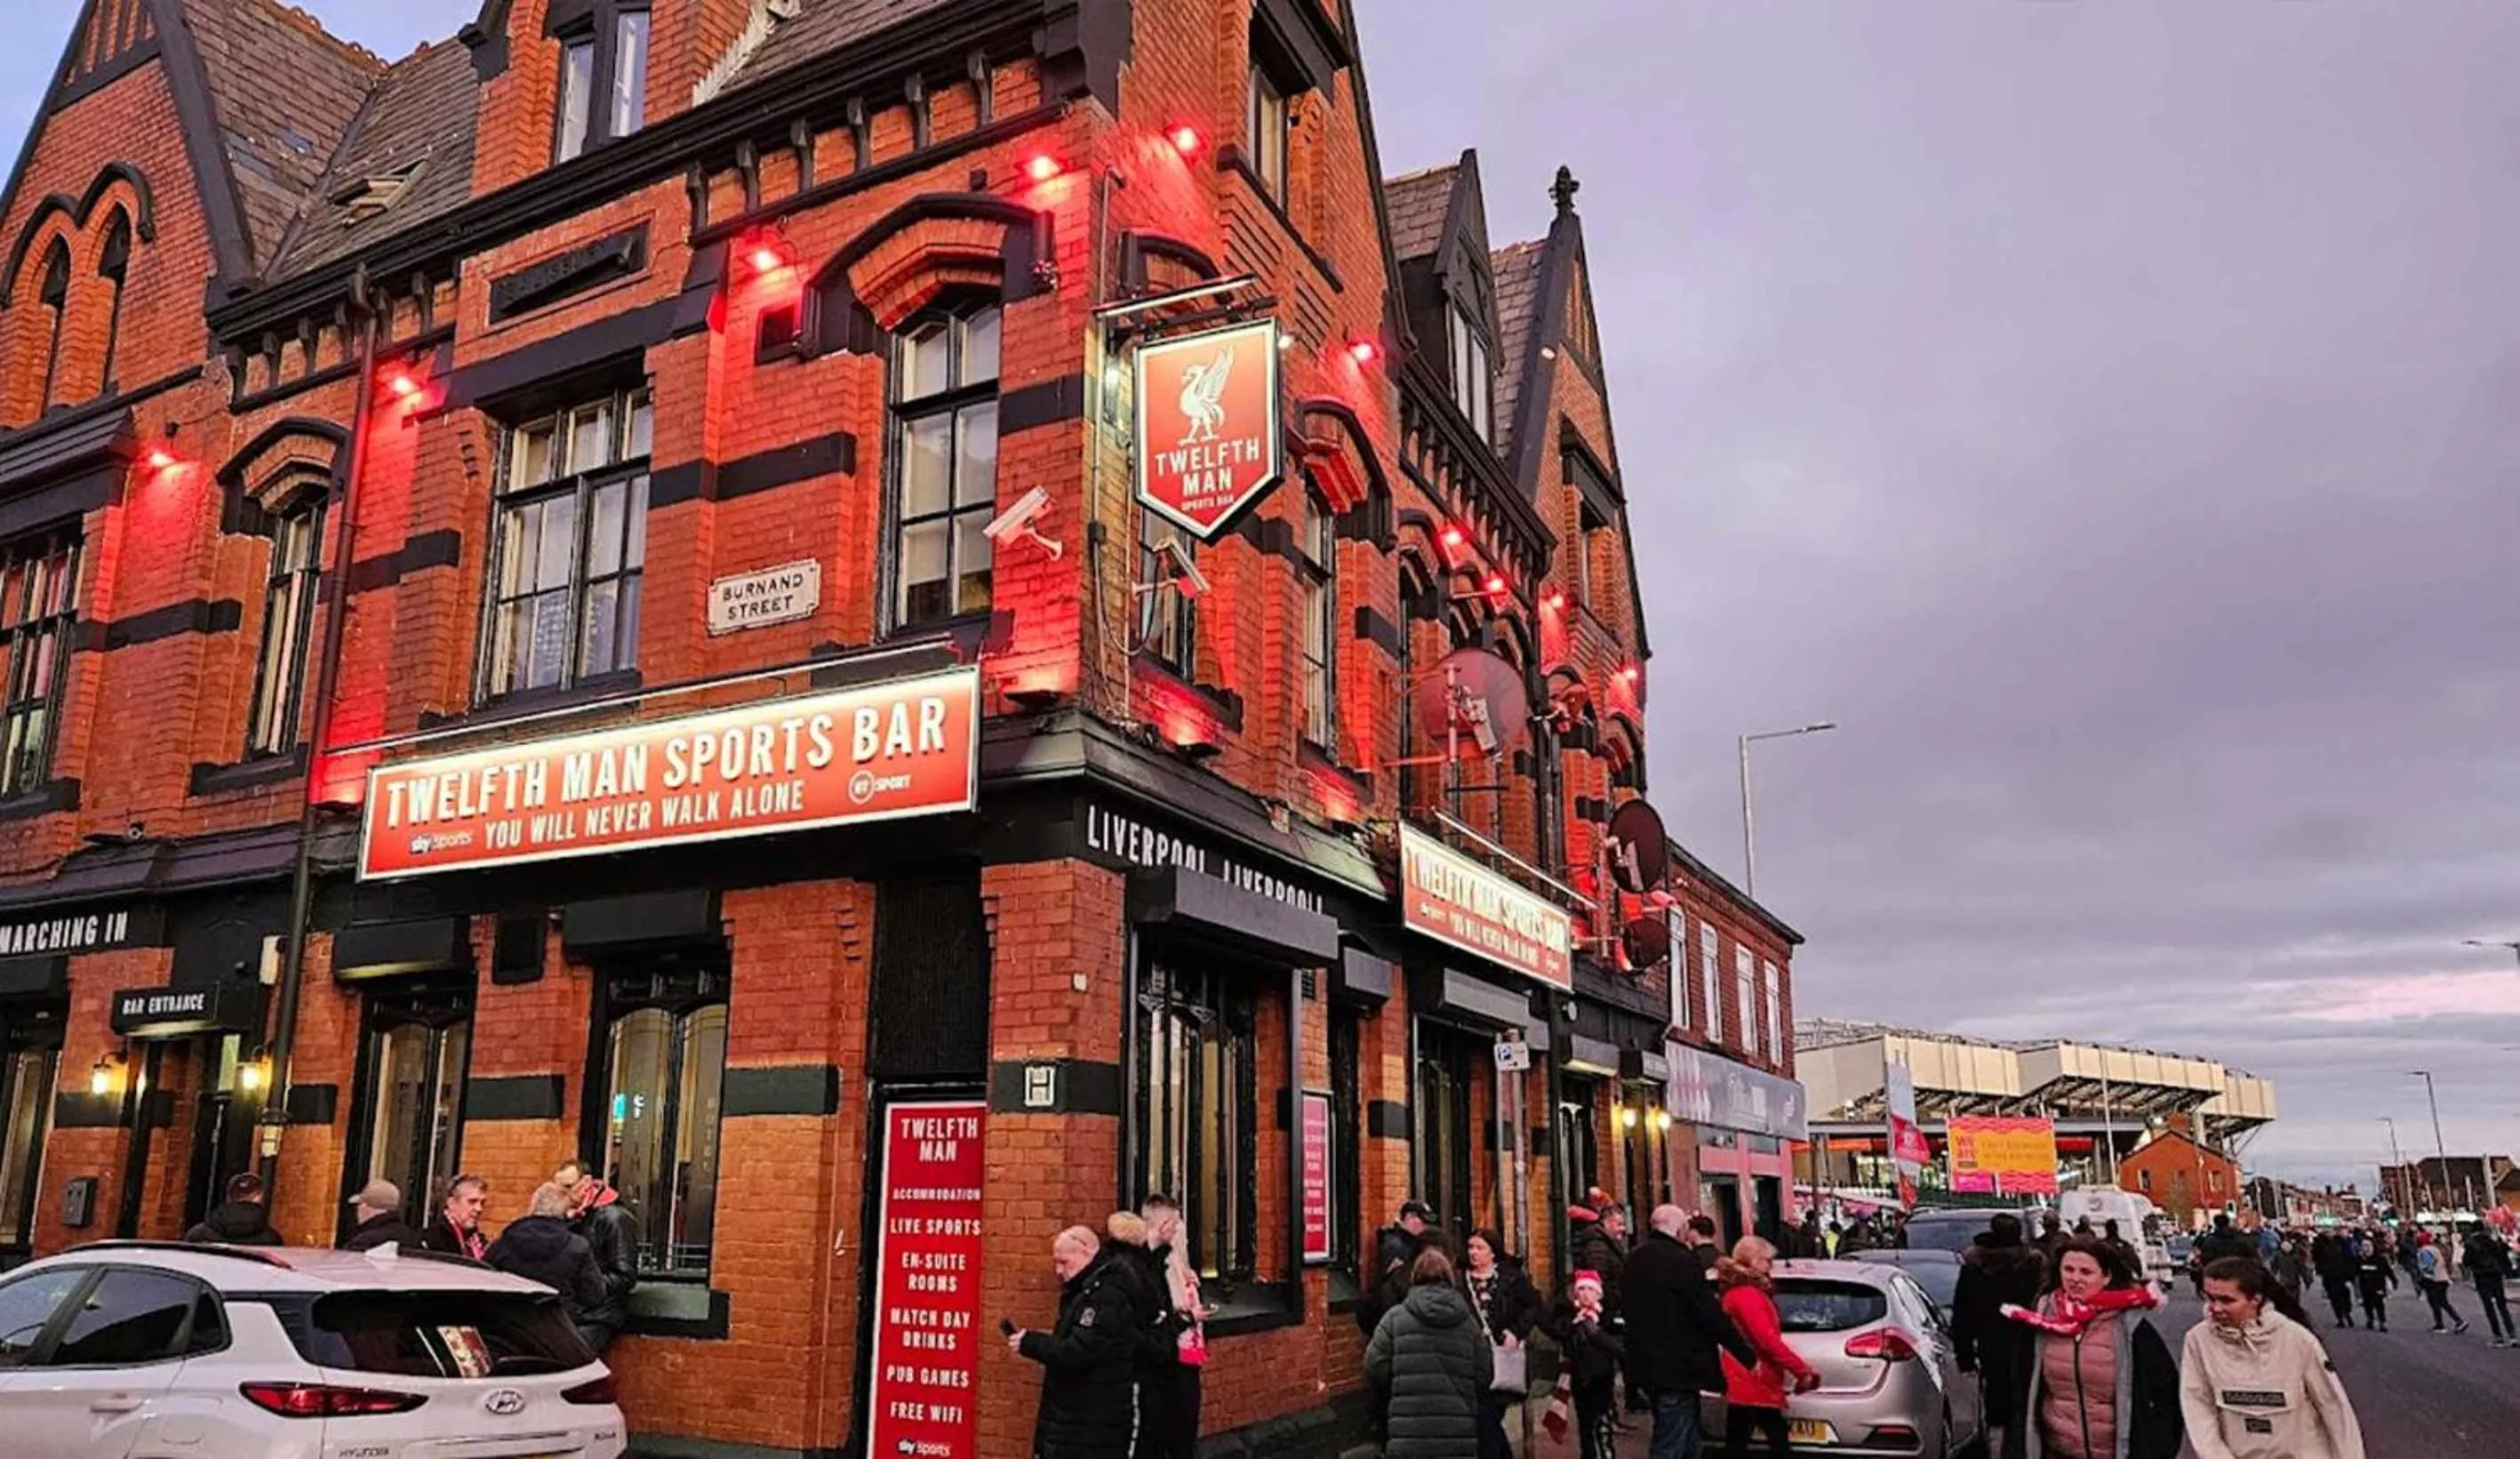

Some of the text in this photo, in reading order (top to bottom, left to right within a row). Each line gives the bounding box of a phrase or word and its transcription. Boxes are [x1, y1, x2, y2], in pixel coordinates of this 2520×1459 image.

[1155, 437, 1260, 476] TWELFTH
[1181, 468, 1233, 496] MAN
[723, 573, 804, 601] BURNAND
[728, 595, 793, 620] STREET
[387, 698, 946, 828] TWELFTH MAN SPORTS BAR
[485, 781, 804, 849] YOU WILL NEVER WALK ALONE
[1088, 805, 1205, 874] LIVERPOOL
[105, 911, 128, 942] IN
[123, 993, 205, 1014] BAR ENTRANCE
[901, 1118, 978, 1139] TWELFTH
[919, 1141, 957, 1161] MAN
[891, 1218, 981, 1235] LIVE SPORTS
[901, 1252, 966, 1270] EN-SUITE
[908, 1274, 957, 1292] ROOMS
[891, 1308, 971, 1328] MATCH DAY
[903, 1331, 956, 1350] DRINKS
[886, 1365, 970, 1388] PUB GAMES
[890, 1401, 963, 1423] FREE WIFI
